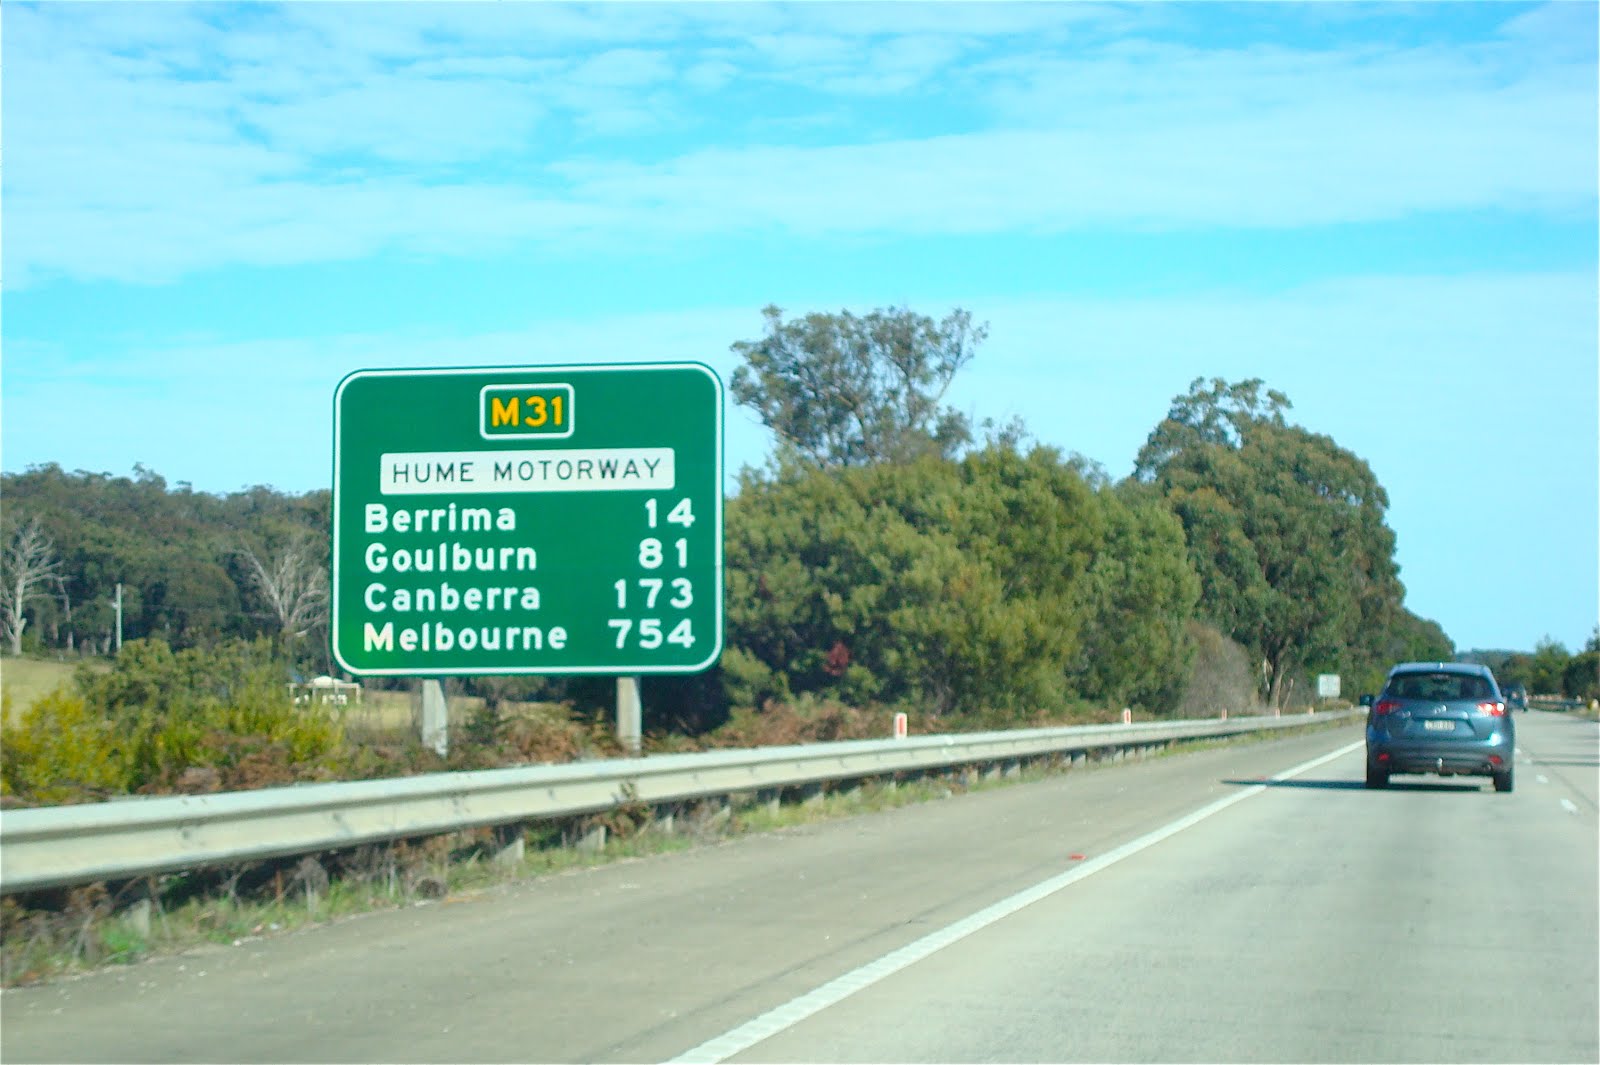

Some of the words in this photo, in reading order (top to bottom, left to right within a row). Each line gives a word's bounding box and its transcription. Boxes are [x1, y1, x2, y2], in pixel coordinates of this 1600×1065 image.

[491, 395, 563, 428] M31
[393, 461, 474, 483] HUME
[493, 458, 661, 481] MOTORWAY
[365, 502, 516, 533] Berrima
[644, 498, 695, 528] 14
[365, 542, 537, 573] Goulburn
[638, 538, 688, 569] 81
[364, 582, 540, 612] Canberra
[614, 578, 694, 609] 173
[364, 622, 567, 652] Melbourne
[608, 619, 695, 649] 754
